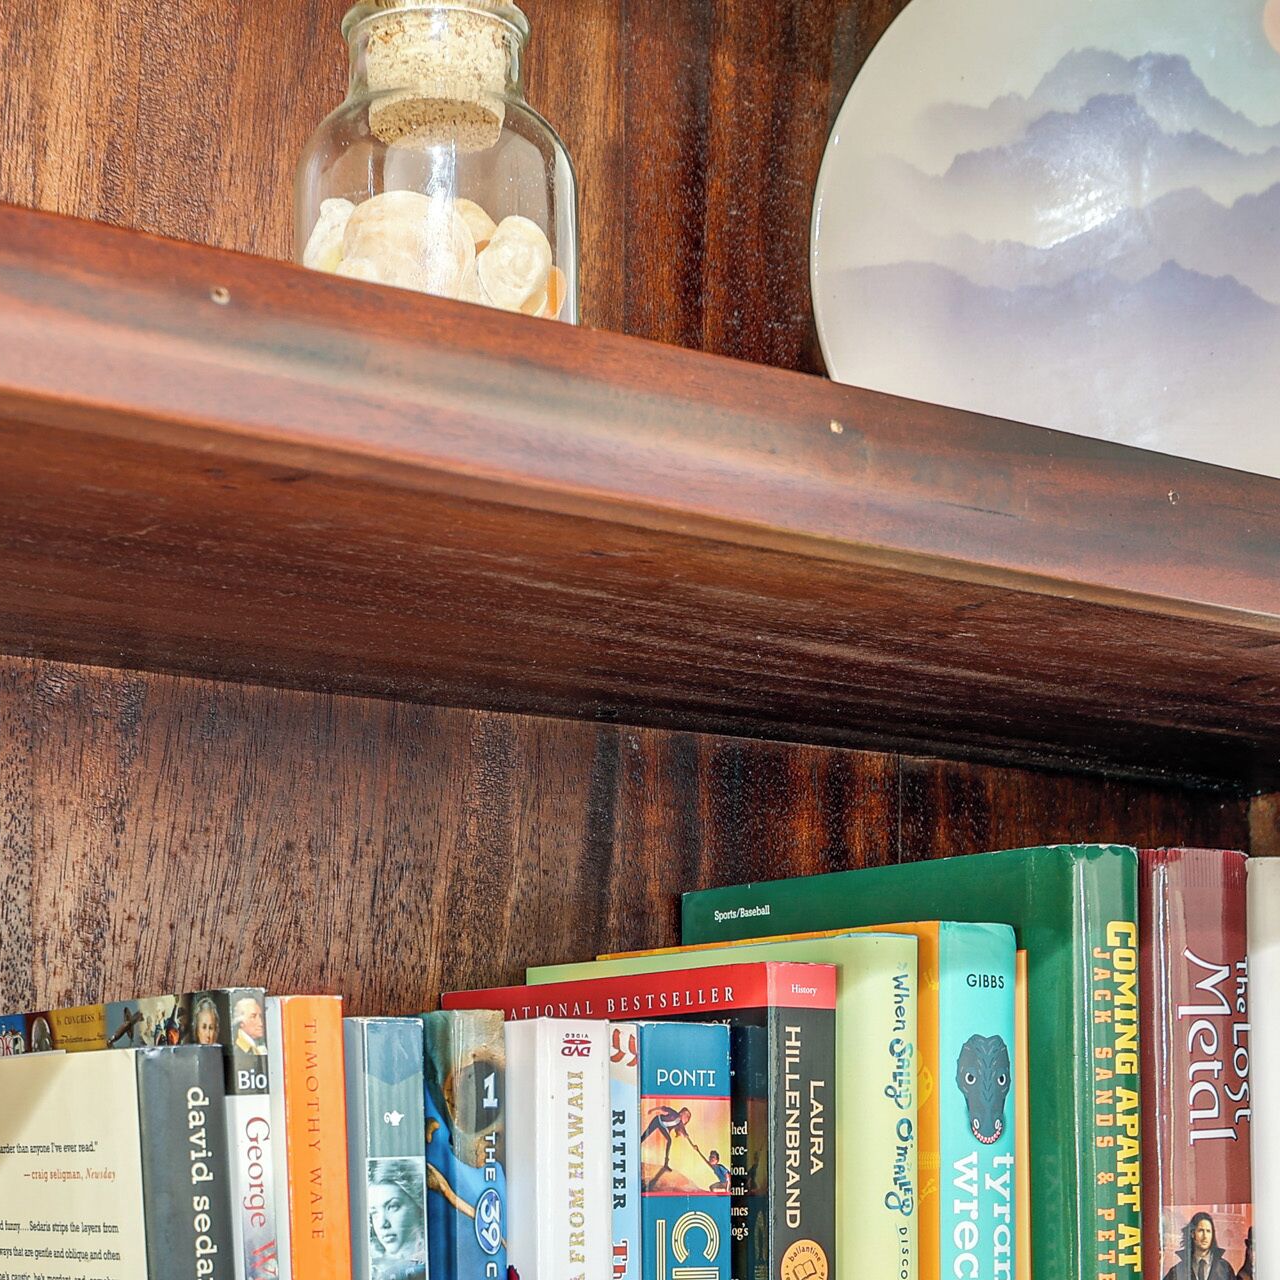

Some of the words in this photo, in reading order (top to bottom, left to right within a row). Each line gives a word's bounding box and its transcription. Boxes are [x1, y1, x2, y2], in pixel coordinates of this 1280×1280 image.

[714, 904, 770, 923] Sports/Baseball
[509, 1000, 594, 1019] ATIONAL
[607, 986, 735, 1013] BESTSELLER
[791, 983, 818, 997] History
[892, 973, 909, 1033] When
[967, 973, 1005, 989] GIBBS
[1093, 947, 1111, 1024] JACK
[1106, 920, 1138, 1076] COMING
[1234, 957, 1249, 1012] The
[237, 1070, 267, 1090] Bio
[656, 1069, 716, 1088] PONTI
[1176, 946, 1237, 1147] Metal
[304, 1020, 320, 1151] TIMOTHY
[483, 1072, 497, 1108] 1
[1094, 1047, 1113, 1148] SANDS
[63, 1144, 77, 1153] ever
[187, 1086, 213, 1184] david
[483, 1131, 497, 1182] THE
[568, 1070, 585, 1180] HAWAII
[784, 1025, 801, 1230] HILLENBRAND
[809, 1079, 825, 1176] LAURA
[1115, 1087, 1141, 1217] APART
[243, 1116, 271, 1228] George
[612, 1110, 626, 1210] RITTER
[309, 1166, 325, 1240] WARE
[479, 1199, 500, 1246] 39
[569, 1189, 586, 1264] FROM
[788, 1246, 821, 1262] ballantine
[1119, 1226, 1141, 1271] AT
